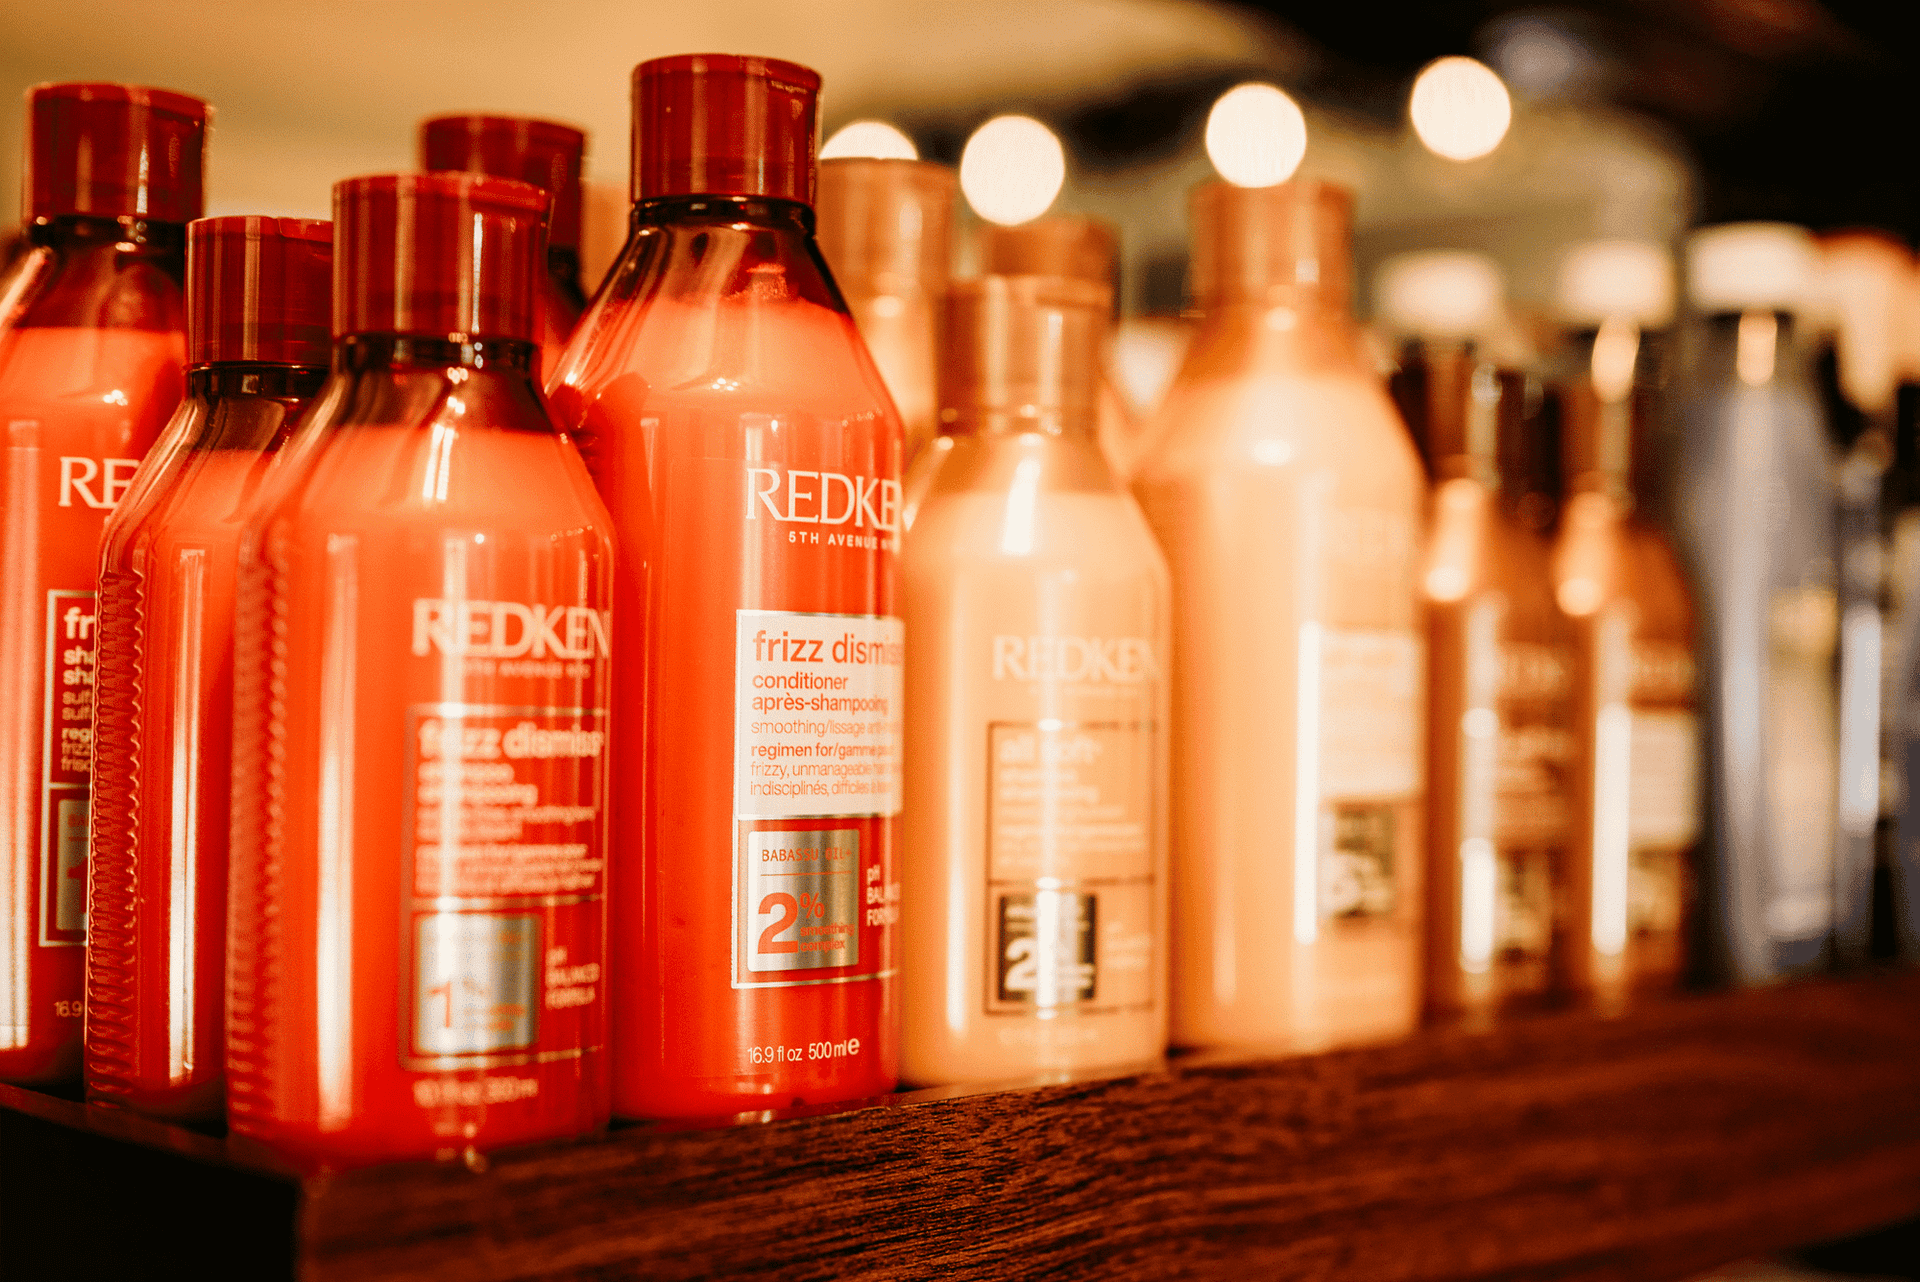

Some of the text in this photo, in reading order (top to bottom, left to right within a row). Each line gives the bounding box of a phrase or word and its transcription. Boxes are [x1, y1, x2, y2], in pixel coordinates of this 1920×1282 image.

[746, 468, 904, 532] REDKE
[789, 531, 819, 544] 5TH
[828, 533, 878, 550] AVENUE
[753, 630, 824, 662] frizz
[752, 671, 849, 690] conditioner
[752, 692, 888, 716] après-shampooing
[751, 719, 865, 737] smoothing/lissage
[751, 742, 812, 760] regimen
[751, 761, 790, 780] frizzy,
[751, 780, 830, 798] indisciplinés,
[762, 849, 819, 862] BABASSU
[800, 922, 855, 937] smoothing
[800, 938, 846, 954] complex
[747, 1046, 774, 1063] 16.9
[777, 1045, 785, 1062] fl
[787, 1048, 803, 1061] oz
[808, 1041, 832, 1060] 500
